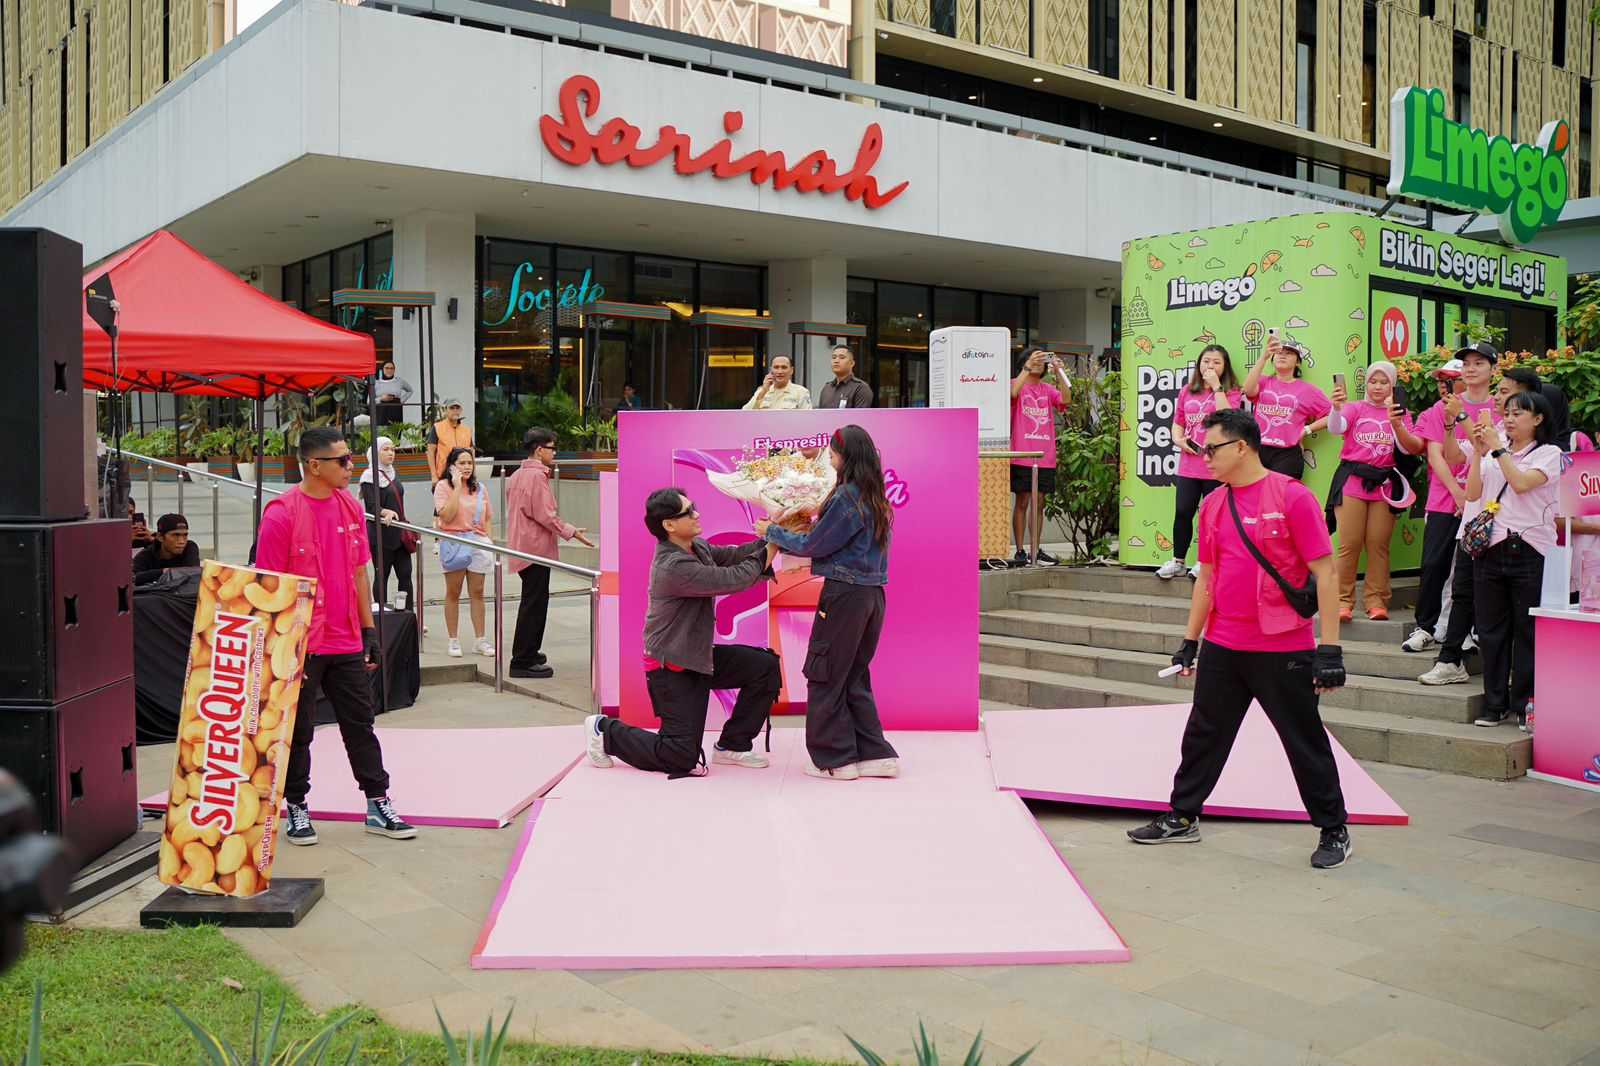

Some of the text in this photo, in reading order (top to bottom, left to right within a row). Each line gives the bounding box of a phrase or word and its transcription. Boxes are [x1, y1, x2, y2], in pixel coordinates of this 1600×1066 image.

[540, 75, 909, 208] Sarinah
[1408, 88, 1568, 230] Limego
[1381, 230, 1545, 295] Bikin Seger Lagi!
[1169, 275, 1256, 307] Limego
[1137, 361, 1196, 392] Dari
[1137, 395, 1178, 420] Po
[1137, 422, 1181, 453] Se
[189, 613, 253, 832] SILVERQUEEN
